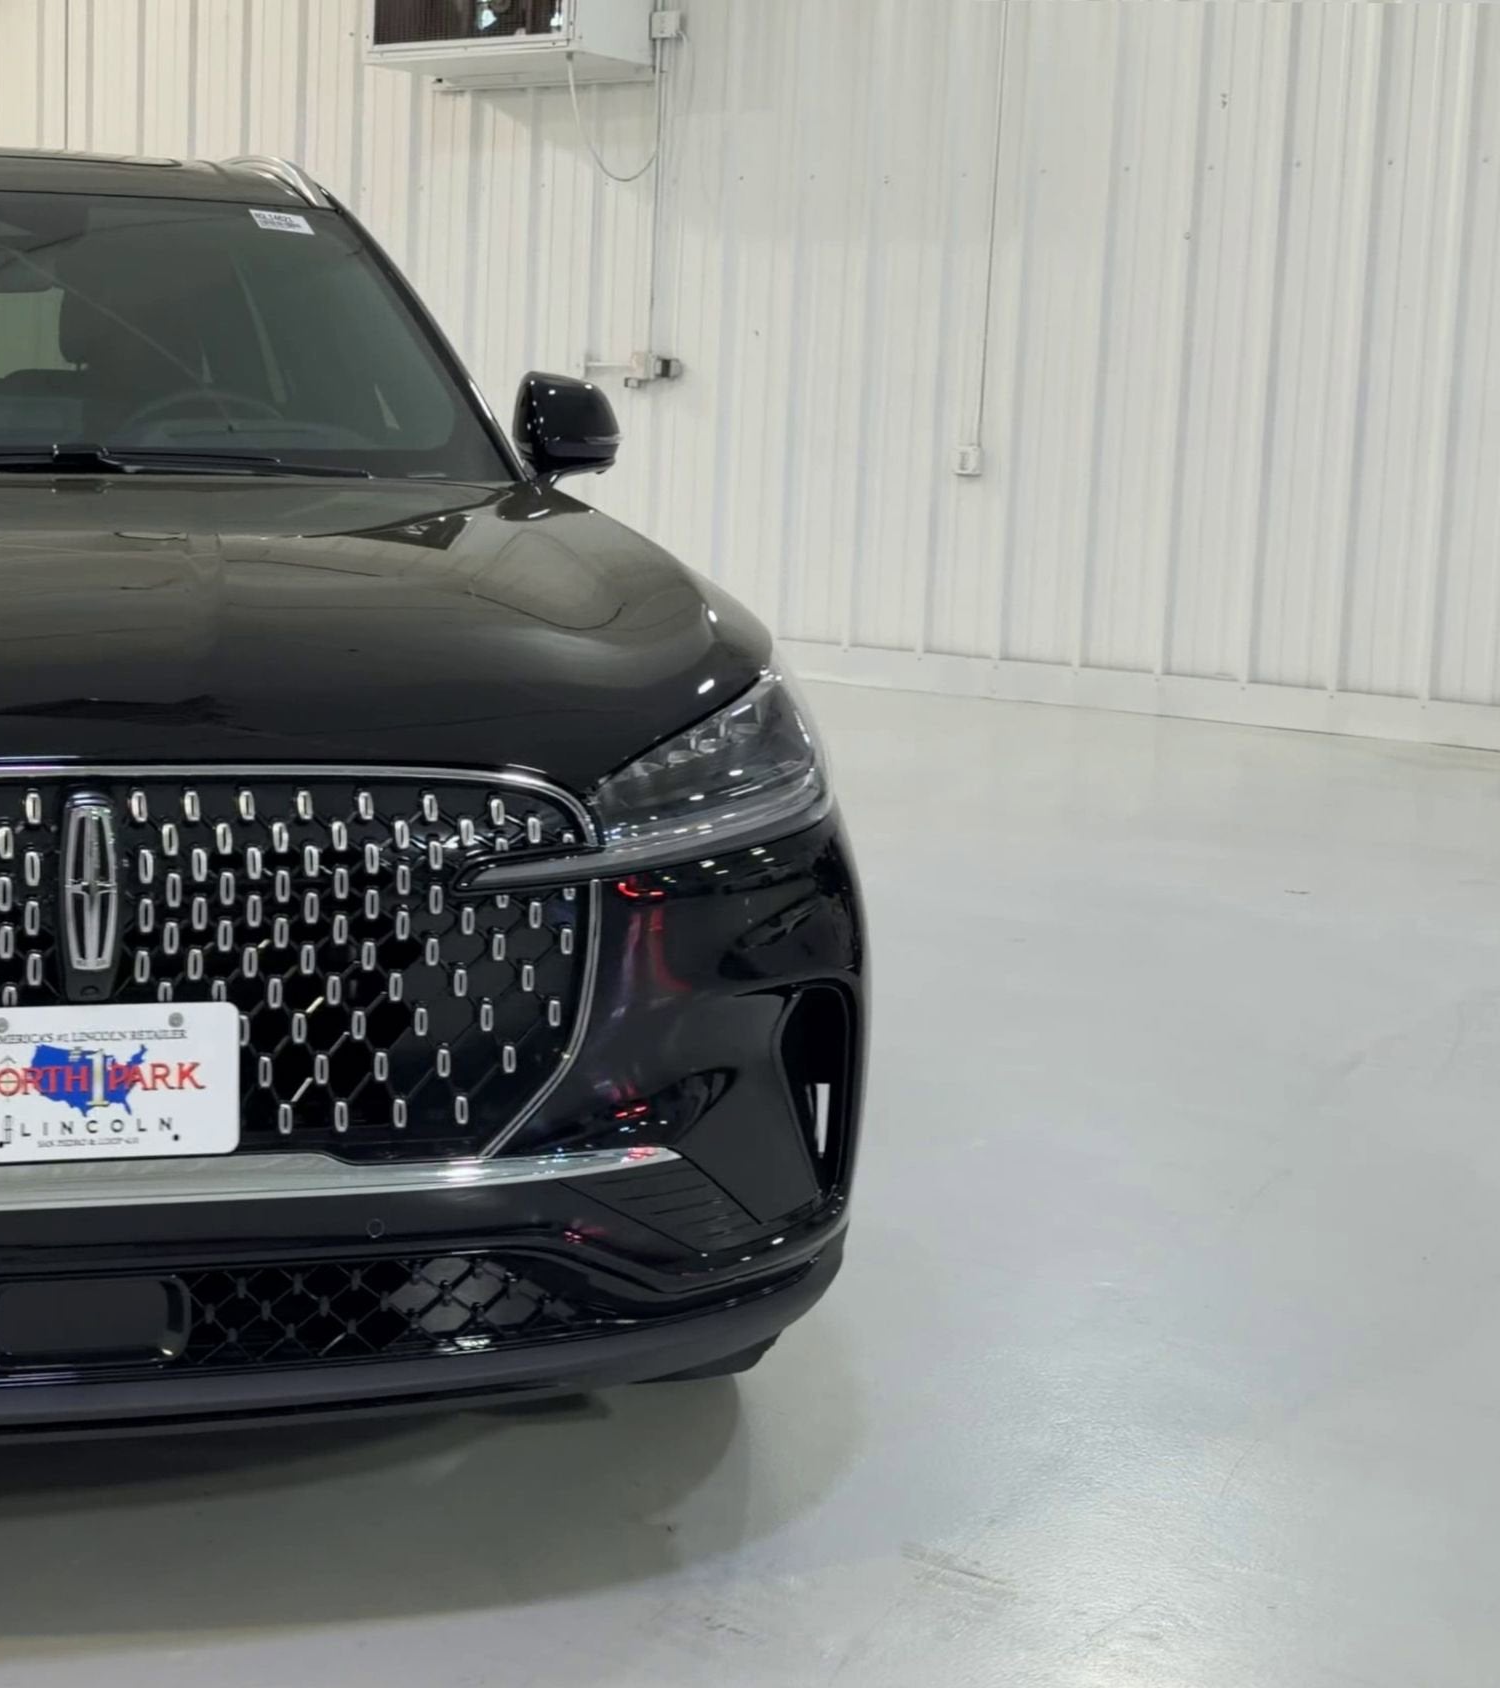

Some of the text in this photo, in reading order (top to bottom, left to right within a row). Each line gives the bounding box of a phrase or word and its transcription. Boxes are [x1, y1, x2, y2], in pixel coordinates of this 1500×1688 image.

[72, 1031, 129, 1042] LINCOLN
[130, 1029, 188, 1040] RETAILER
[108, 1062, 206, 1091] PARK
[20, 1117, 172, 1136] LINCOLN
